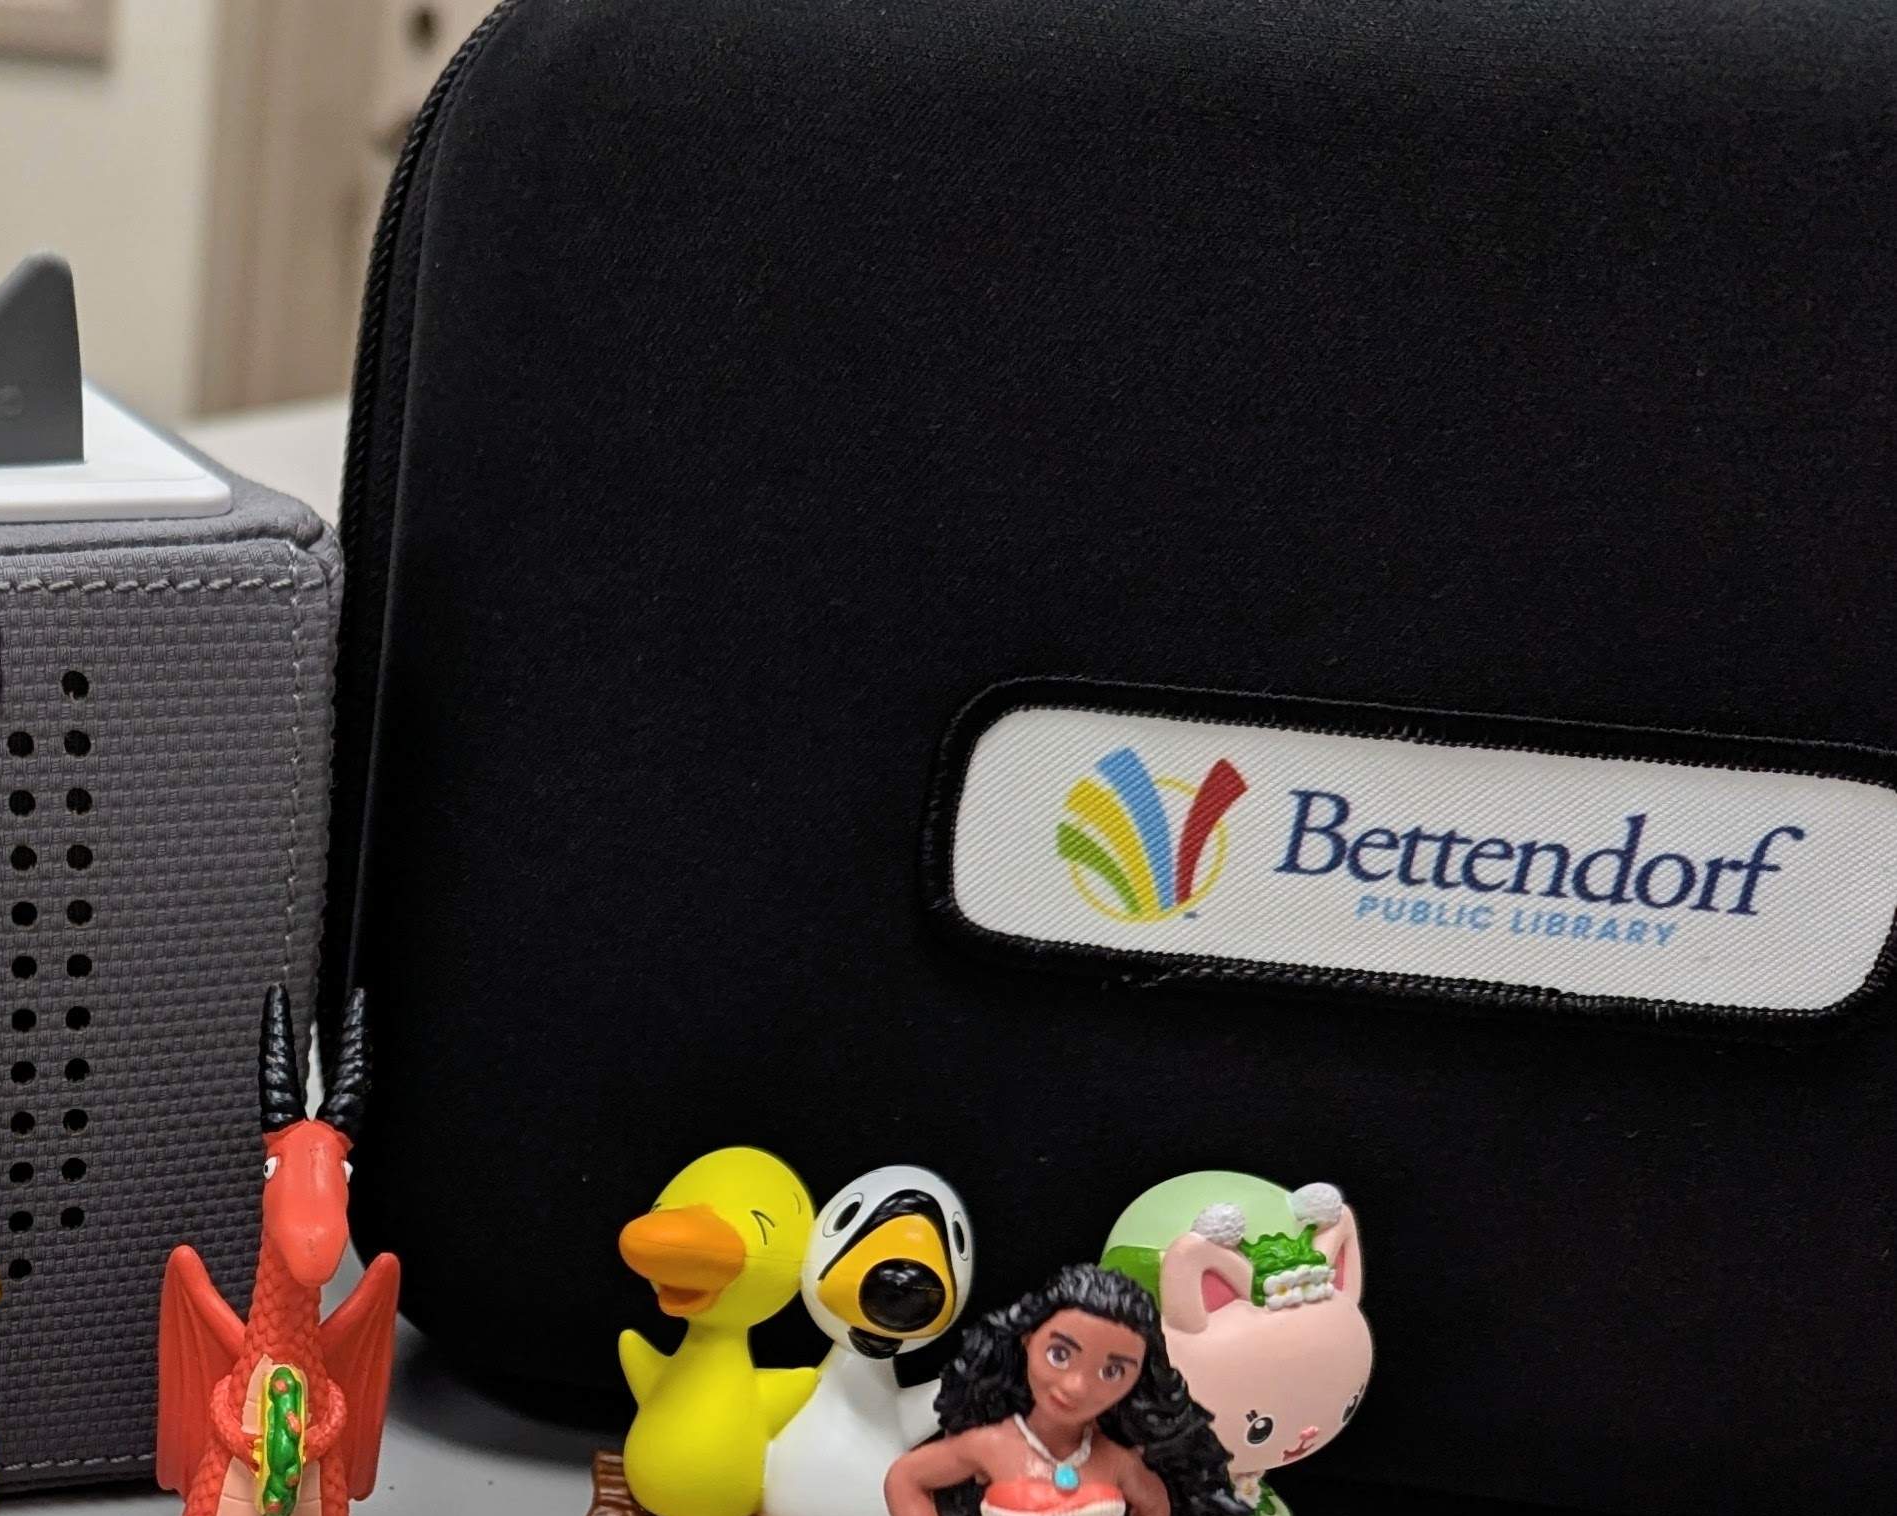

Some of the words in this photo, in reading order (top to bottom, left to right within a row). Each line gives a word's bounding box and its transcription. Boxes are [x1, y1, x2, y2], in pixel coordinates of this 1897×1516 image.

[1274, 790, 1805, 917] Bettendorf
[1355, 894, 1493, 932] PUBLIC
[1511, 907, 1679, 947] LIBRARY
